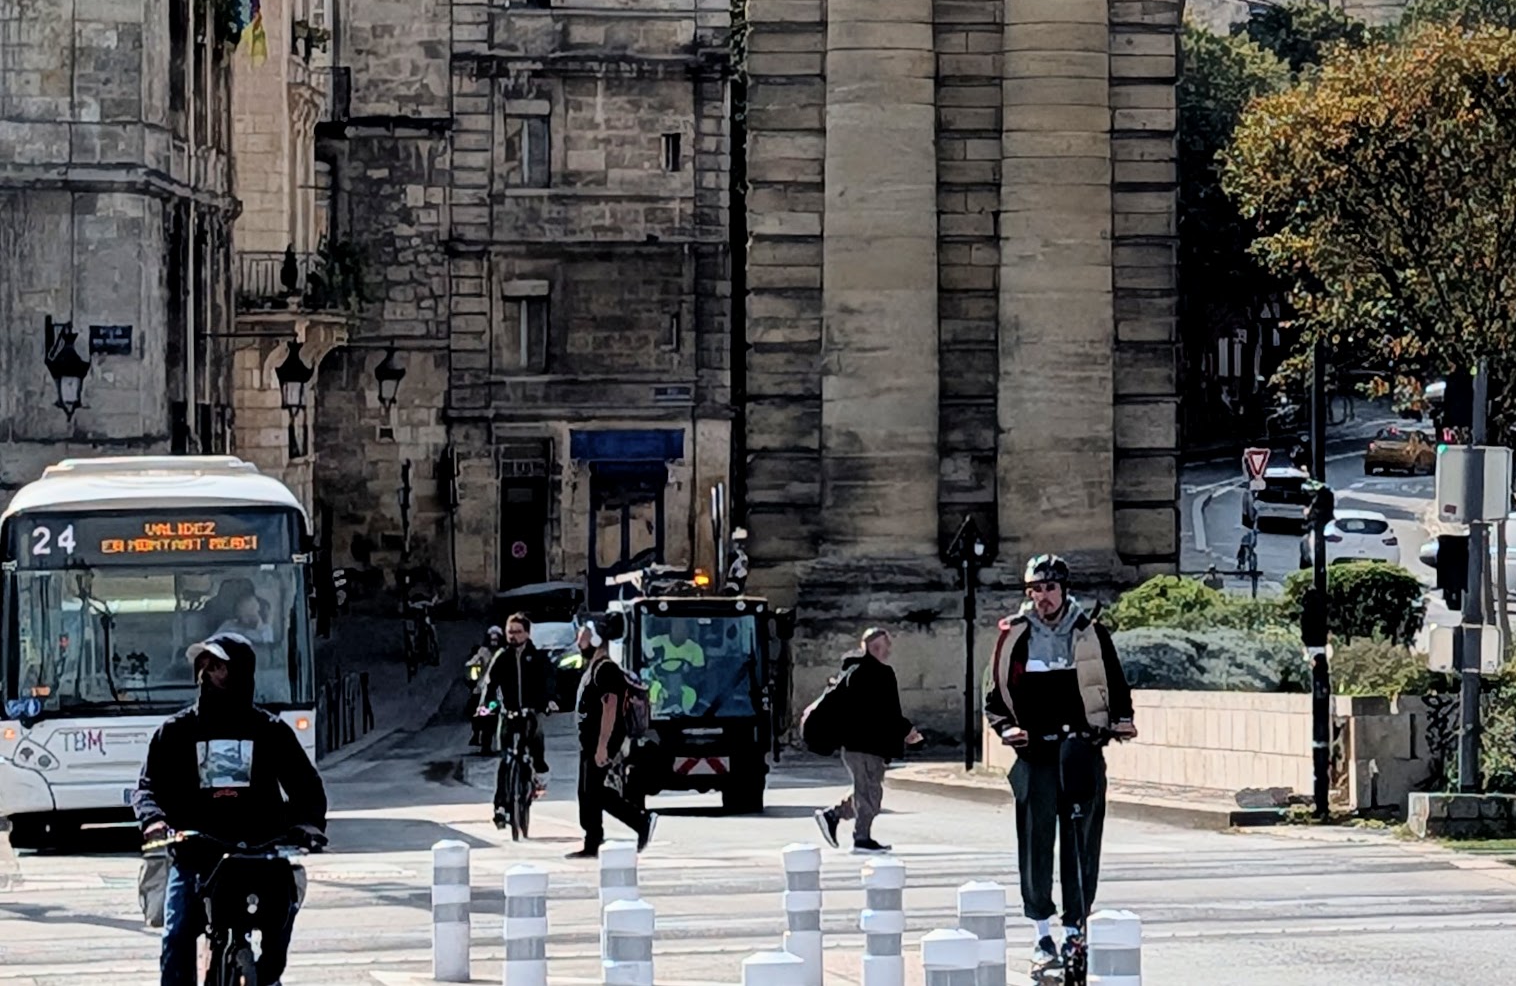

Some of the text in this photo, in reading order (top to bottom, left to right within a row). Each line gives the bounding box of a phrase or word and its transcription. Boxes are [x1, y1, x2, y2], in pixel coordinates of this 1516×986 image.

[32, 524, 76, 555] 24
[144, 522, 216, 536] VALIDEZ
[58, 729, 106, 755] TBM
